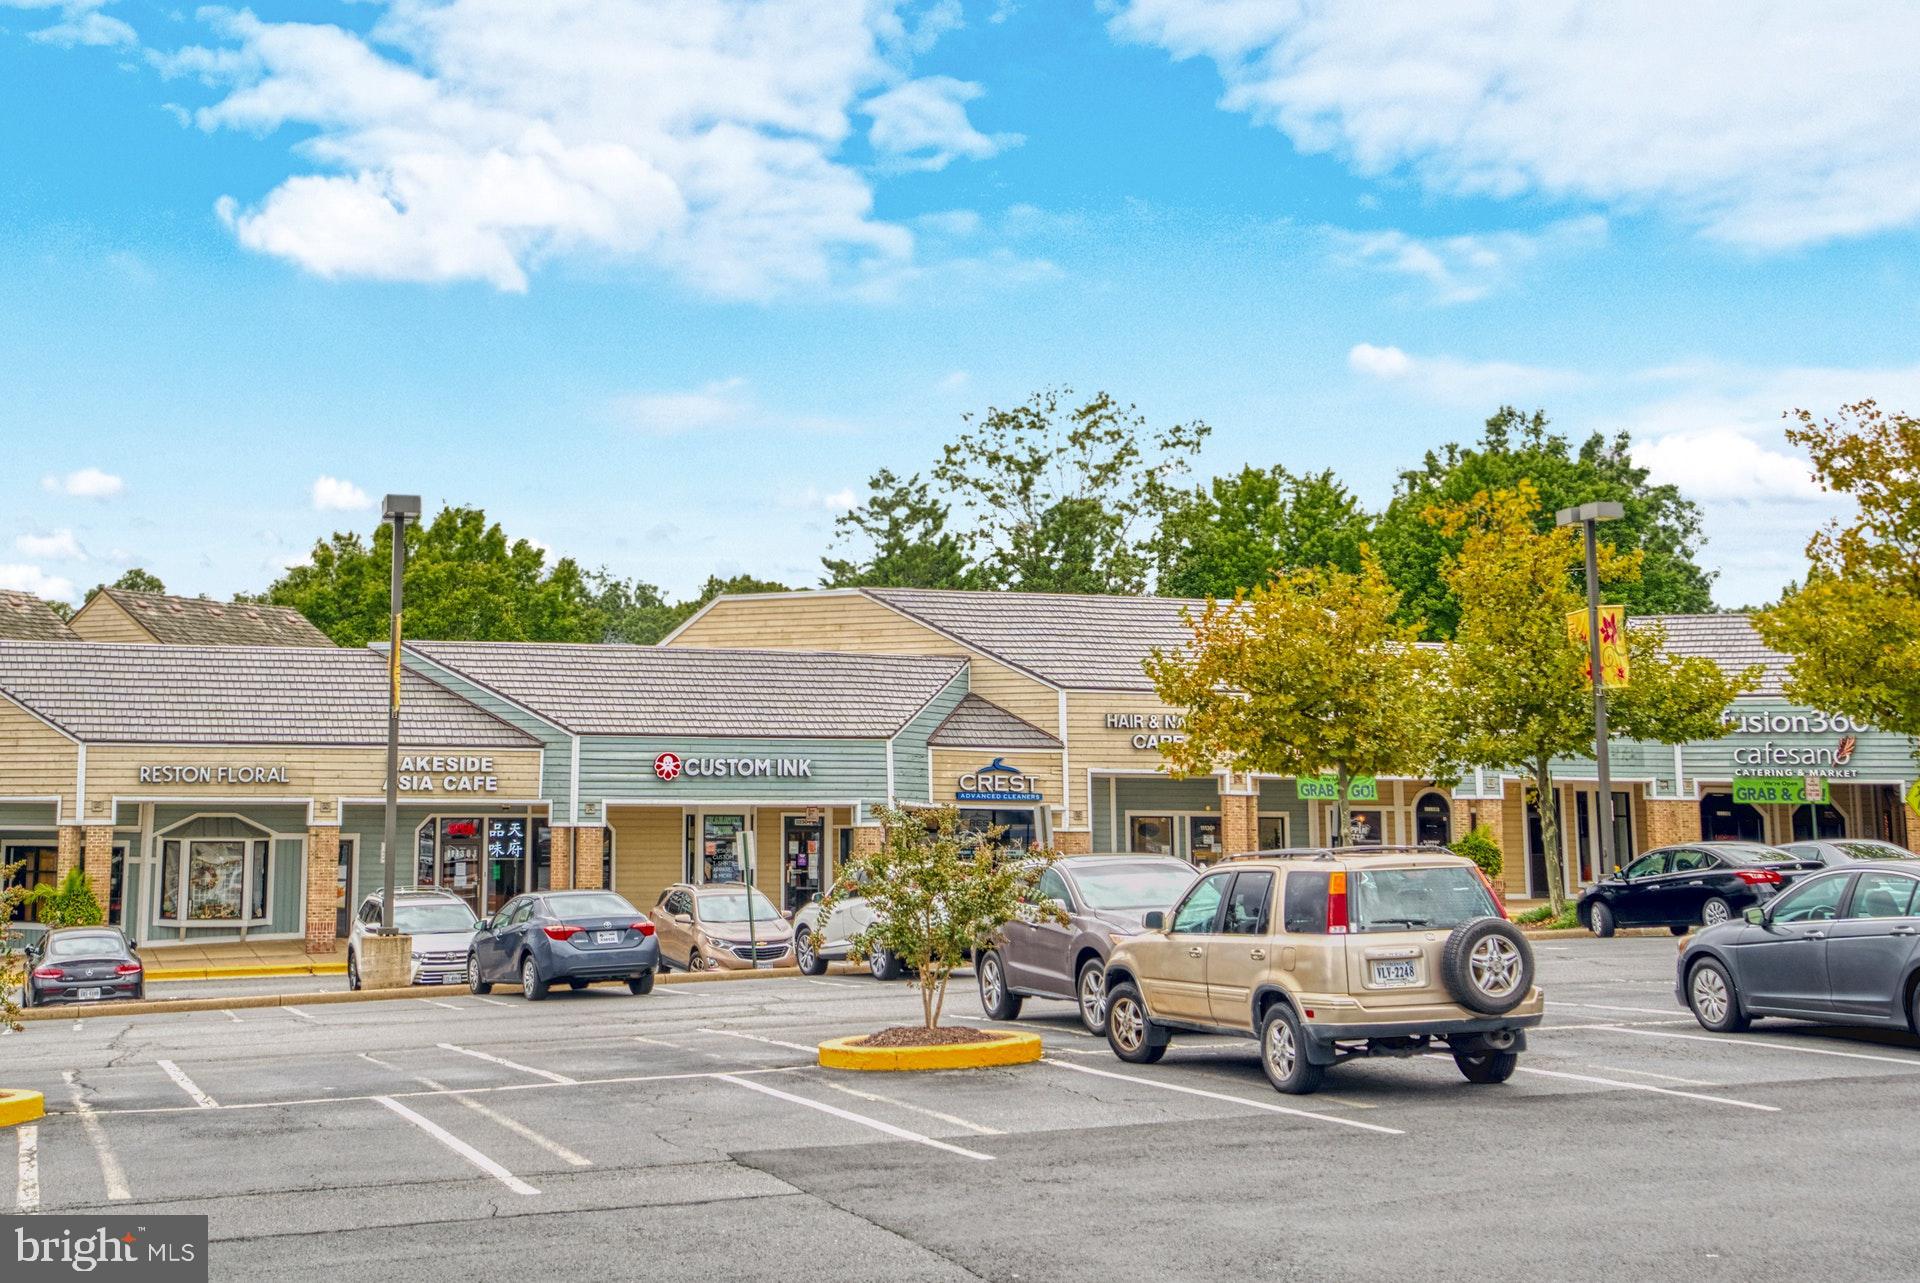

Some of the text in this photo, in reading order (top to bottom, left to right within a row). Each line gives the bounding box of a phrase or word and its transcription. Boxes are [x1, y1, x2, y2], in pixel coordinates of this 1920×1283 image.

[1106, 713, 1144, 728] HAIR
[1148, 714, 1159, 729] &
[1733, 741, 1851, 765] cafesano
[397, 756, 494, 772] AKESIDE
[684, 758, 812, 777] CUSTOM INK
[139, 765, 290, 783] RESTON FLORAL
[1735, 768, 1858, 778] CATERING & MARKET
[443, 775, 498, 791] CAFE
[959, 773, 1040, 793] CREST
[1300, 783, 1375, 798] GRAB GO!
[1736, 787, 1778, 801] GRAB
[1781, 787, 1793, 801] &
[1797, 787, 1825, 802] G!
[1376, 966, 1415, 979] VLV-2248
